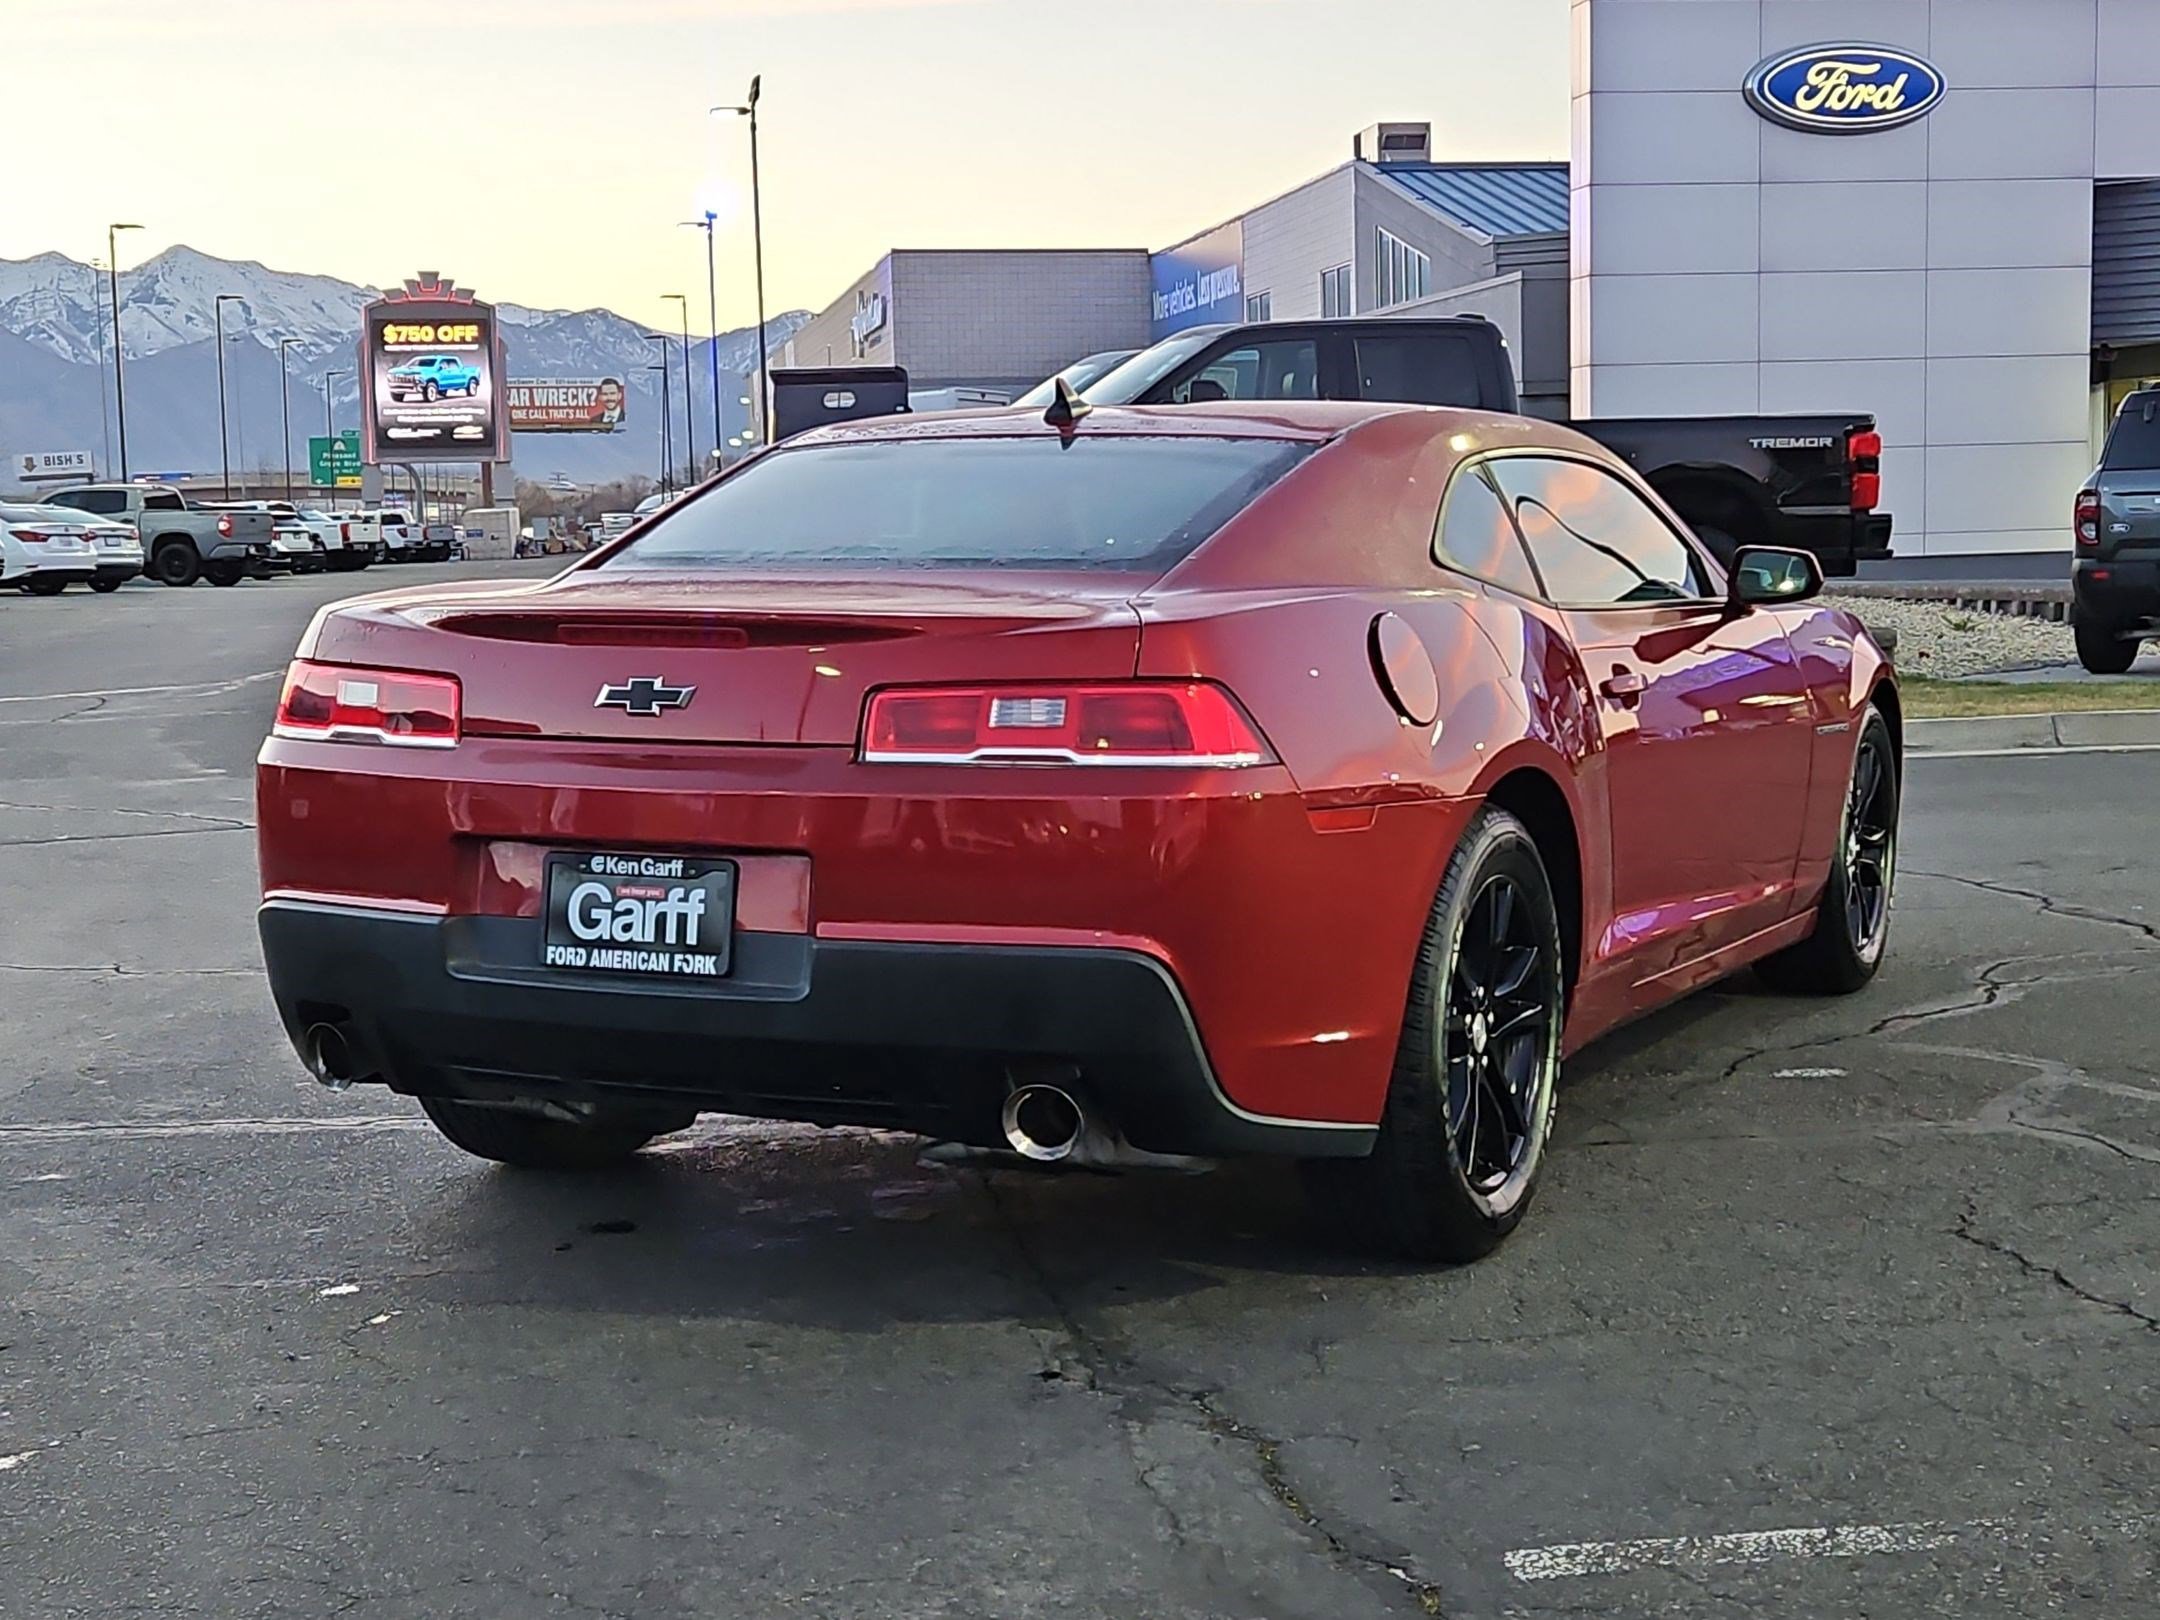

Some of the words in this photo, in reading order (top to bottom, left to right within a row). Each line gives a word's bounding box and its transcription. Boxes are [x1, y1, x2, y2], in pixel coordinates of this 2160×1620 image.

[1795, 60, 1909, 111] Ford
[383, 323, 435, 344] $750
[437, 325, 479, 342] OFF
[507, 388, 530, 407] AR
[532, 387, 598, 407] WRECK?
[511, 408, 528, 420] ONE
[528, 408, 548, 420] CALL
[549, 408, 575, 420] THAT'S
[575, 408, 590, 419] ALL
[1748, 437, 1833, 449] TREMOR
[43, 454, 84, 467] BISH'S
[606, 856, 640, 876] Ken
[640, 858, 684, 878] Garff
[567, 881, 706, 946] Garff
[546, 945, 587, 967] FORD
[589, 948, 670, 973] AMERICAN
[673, 953, 718, 976] FORK
